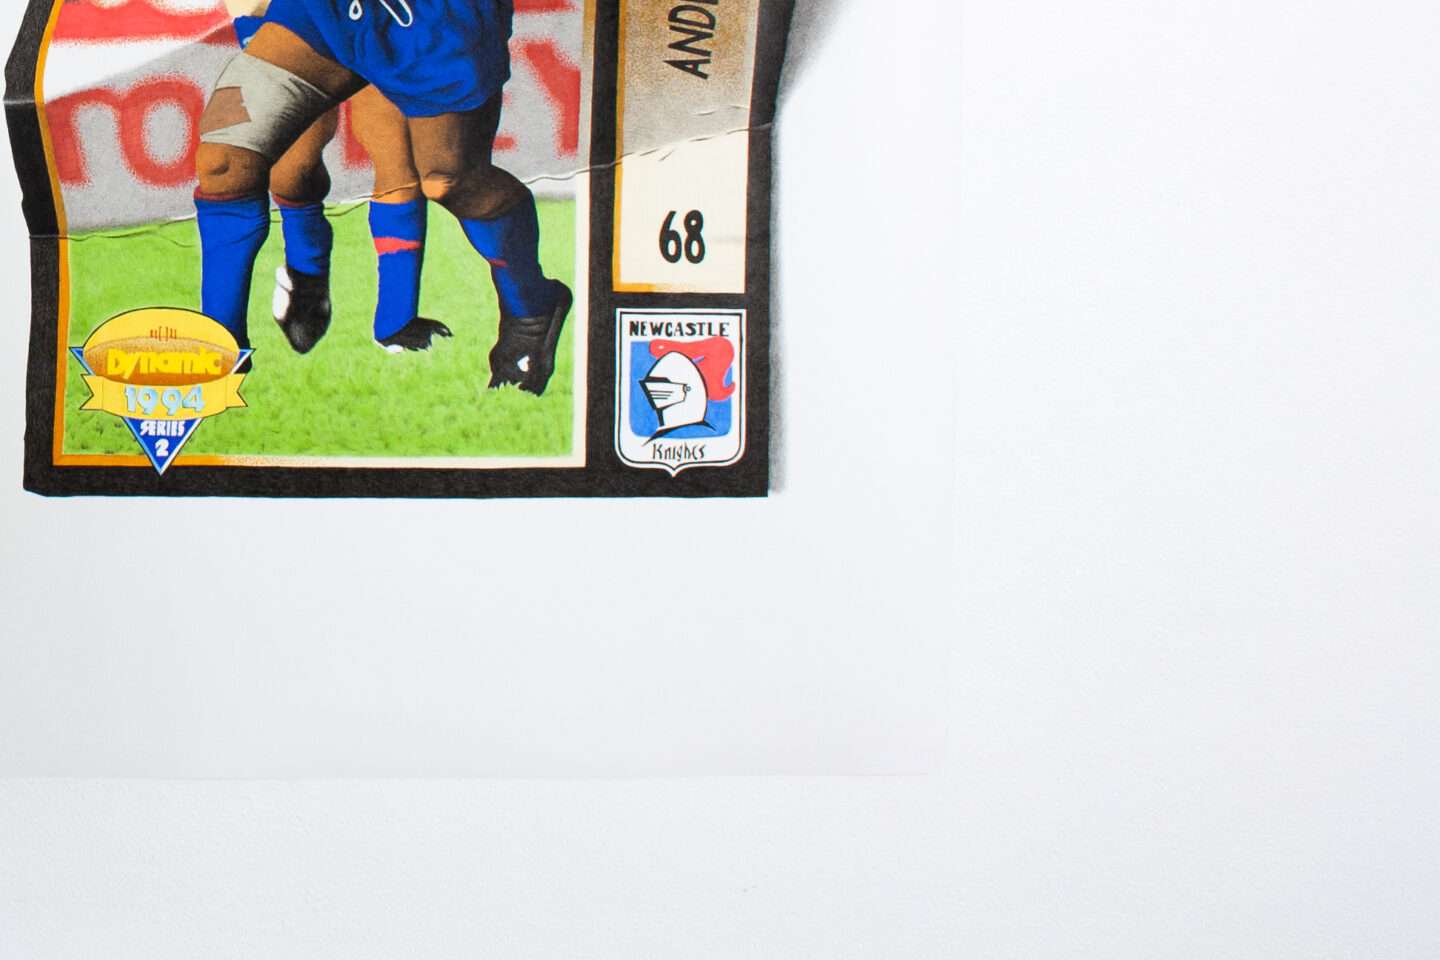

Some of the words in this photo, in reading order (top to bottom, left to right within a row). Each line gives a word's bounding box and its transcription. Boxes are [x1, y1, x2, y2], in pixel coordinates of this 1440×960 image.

[658, 209, 706, 264] 68
[629, 320, 731, 337] NEWCASTLE
[106, 346, 223, 380] Dynamic
[124, 384, 206, 416] 1994
[140, 420, 186, 436] SERIES
[154, 438, 169, 457] 2
